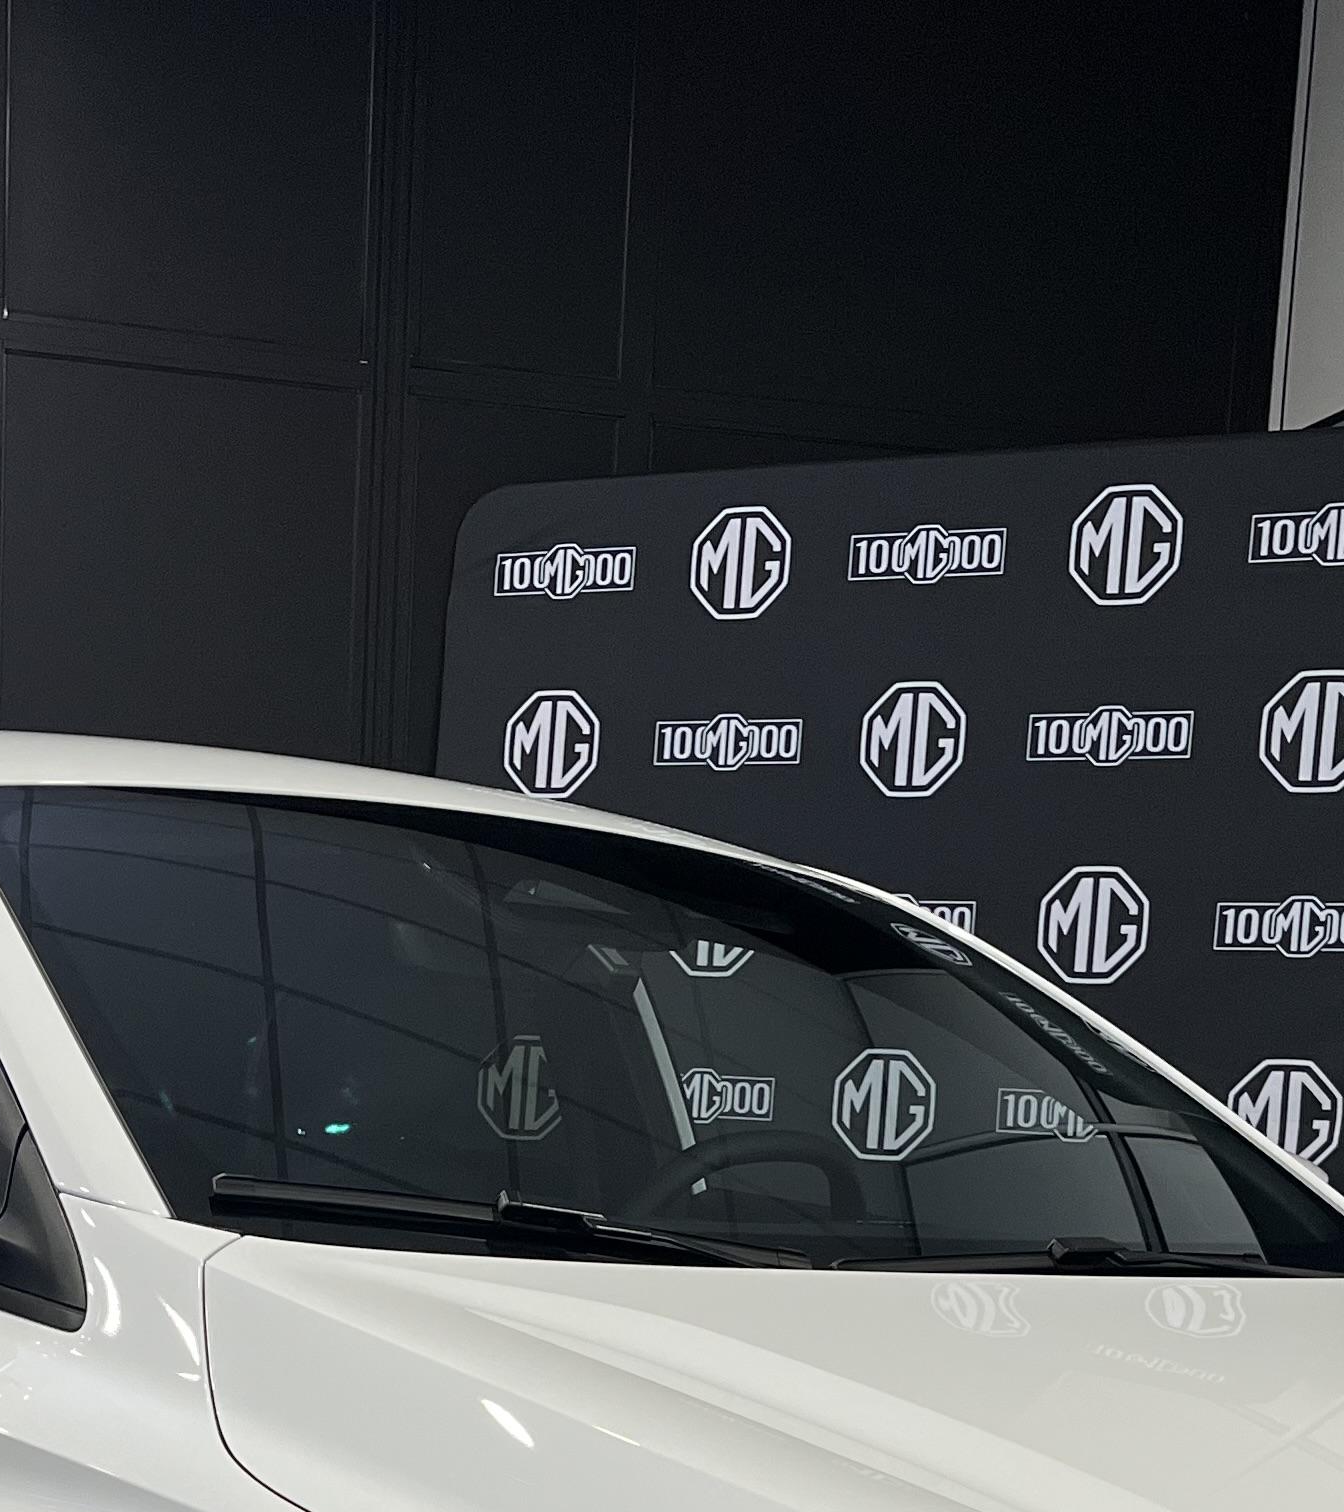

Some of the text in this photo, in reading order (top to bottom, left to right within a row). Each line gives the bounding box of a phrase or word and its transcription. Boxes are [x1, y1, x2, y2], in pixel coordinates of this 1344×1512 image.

[700, 518, 781, 608] MG
[1080, 497, 1172, 593] MG
[513, 701, 590, 788] MG
[870, 693, 955, 786] MG
[1049, 878, 1138, 972] MG
[842, 1060, 925, 1149] MG
[1237, 1070, 1332, 1161] MG
